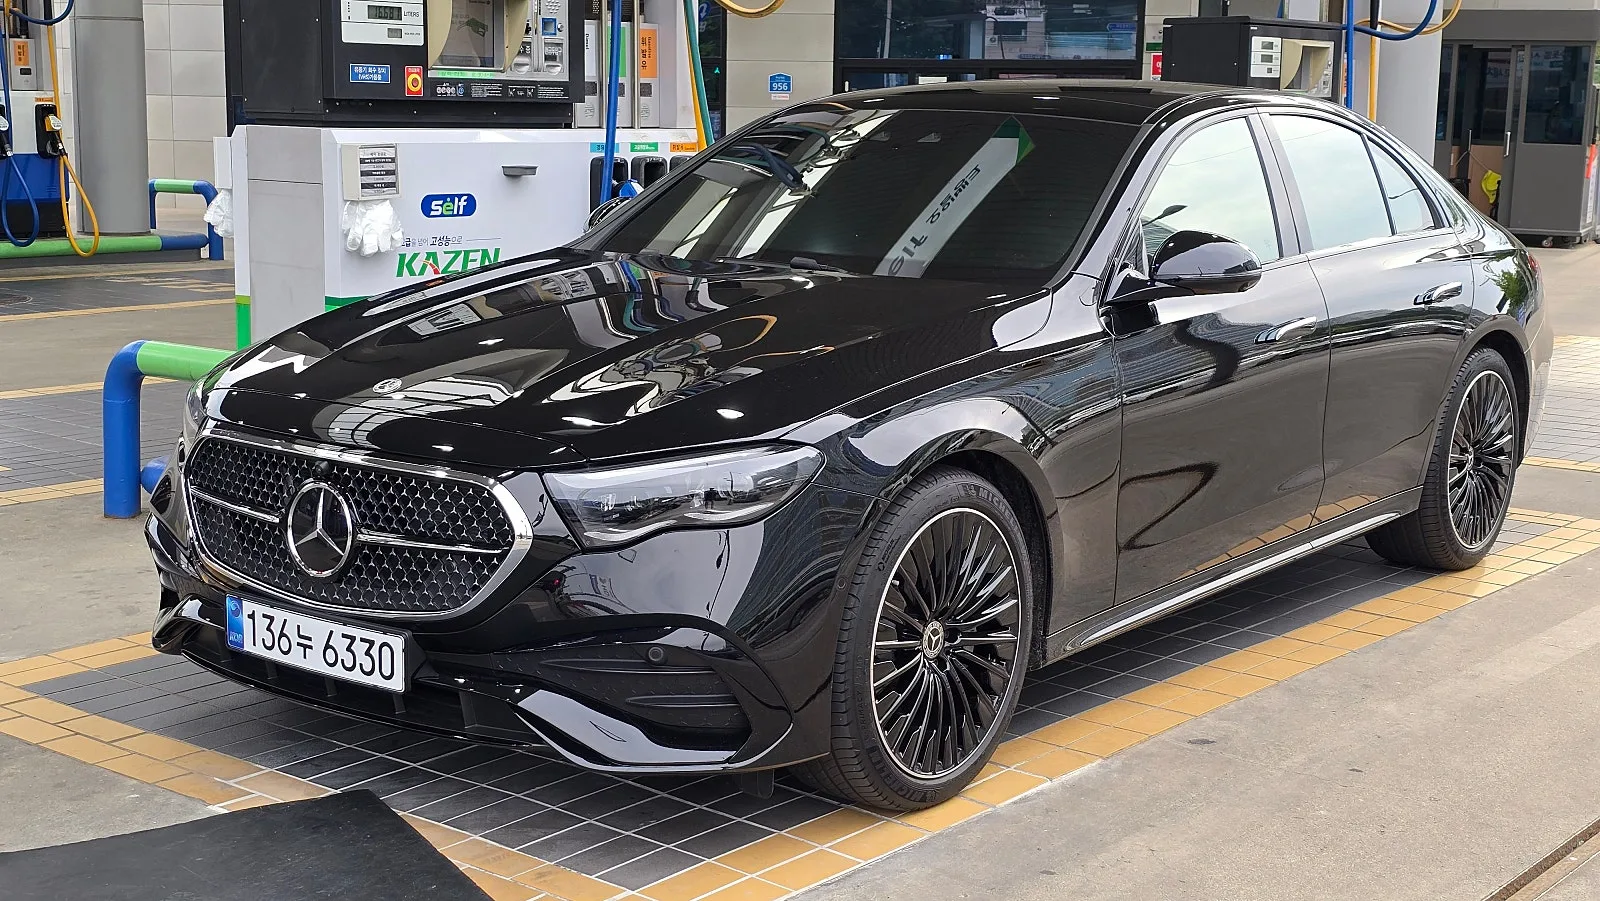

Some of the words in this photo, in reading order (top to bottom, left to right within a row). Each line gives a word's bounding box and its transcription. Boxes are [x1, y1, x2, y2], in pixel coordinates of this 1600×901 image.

[772, 82, 788, 91] 956
[430, 195, 468, 216] self
[396, 247, 501, 278] KAZEN
[247, 609, 314, 660] 136누
[322, 629, 395, 681] 6330
